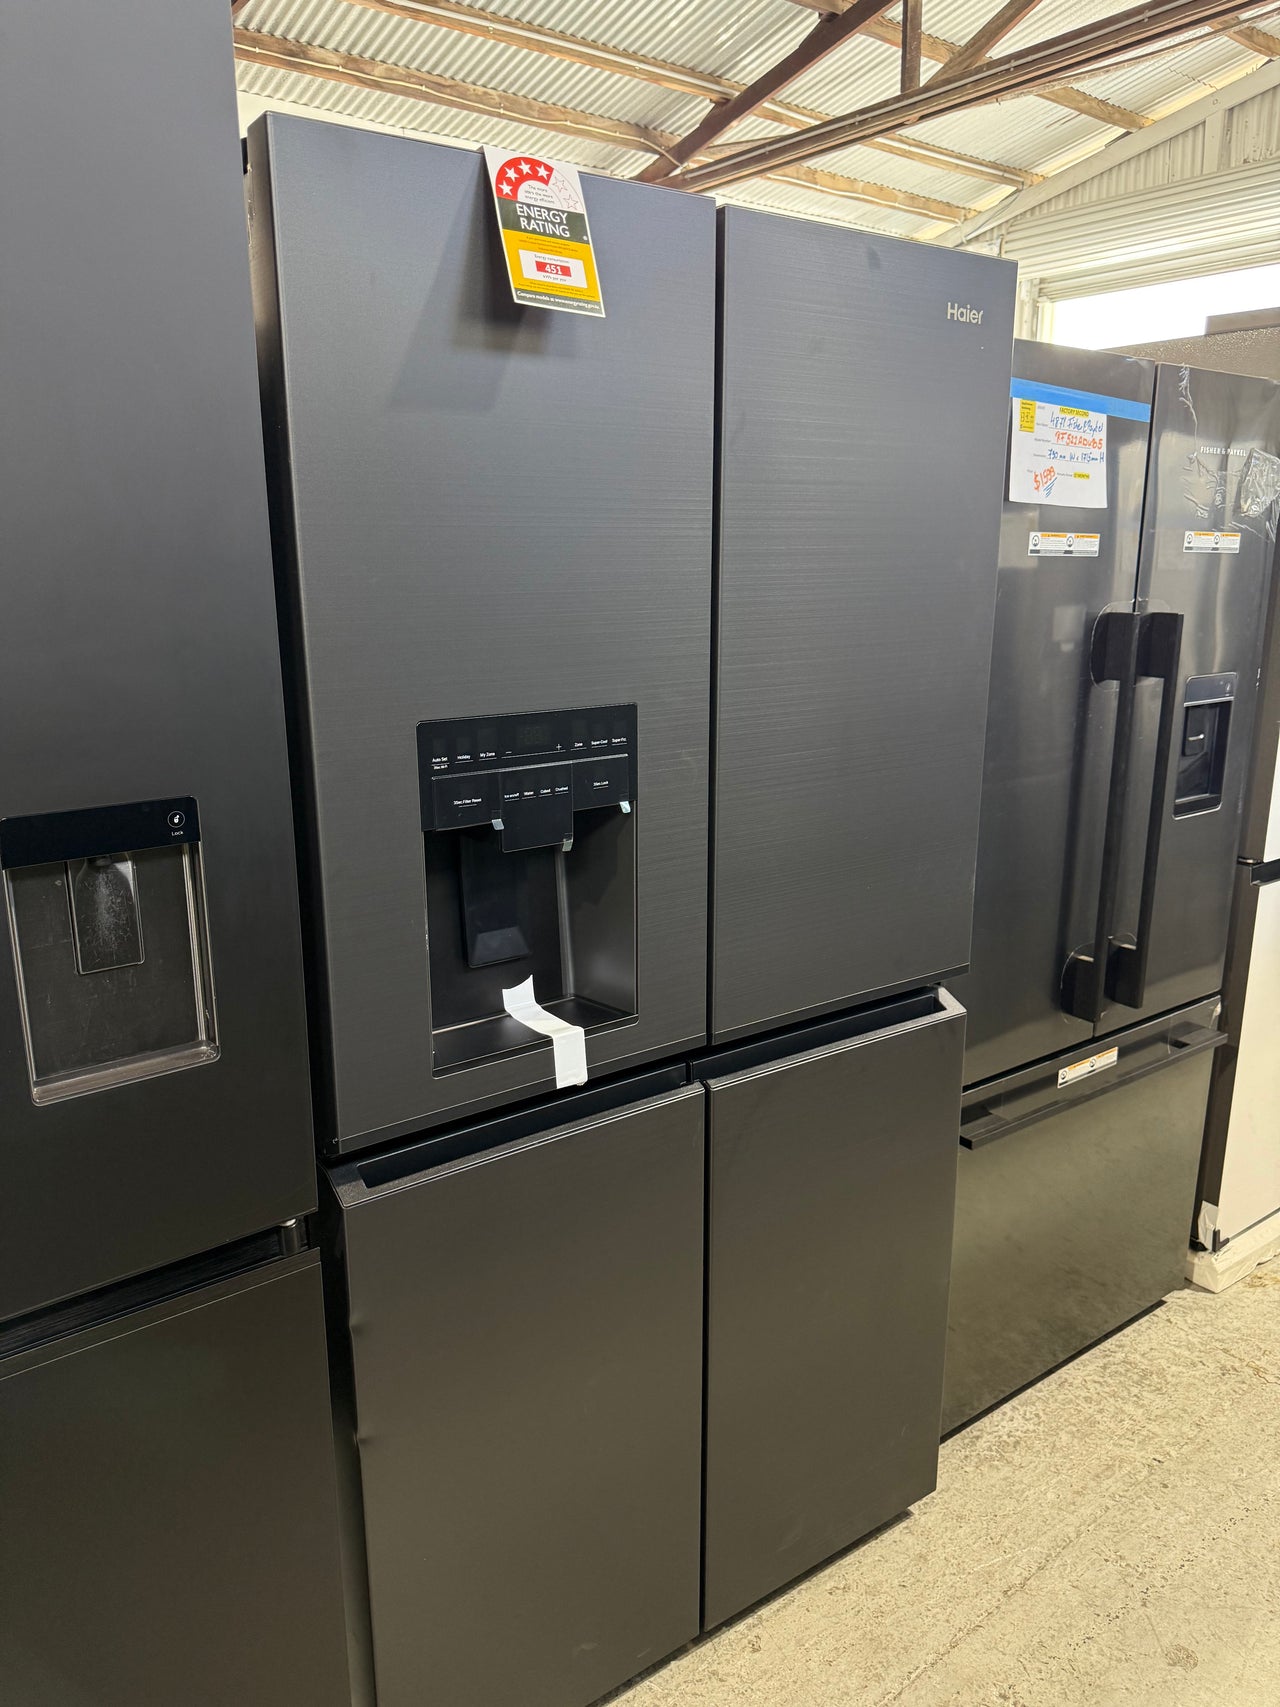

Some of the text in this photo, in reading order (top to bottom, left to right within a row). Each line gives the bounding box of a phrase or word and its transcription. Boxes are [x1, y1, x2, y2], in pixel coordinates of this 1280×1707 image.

[516, 203, 568, 224] ENERGY
[519, 217, 571, 238] RATING
[545, 264, 562, 275] 451
[516, 290, 536, 299] Compare
[947, 302, 983, 325] Haier
[1060, 406, 1076, 415] FACTORY
[1200, 446, 1220, 455] FISHER
[1226, 448, 1246, 457] PAYKEL
